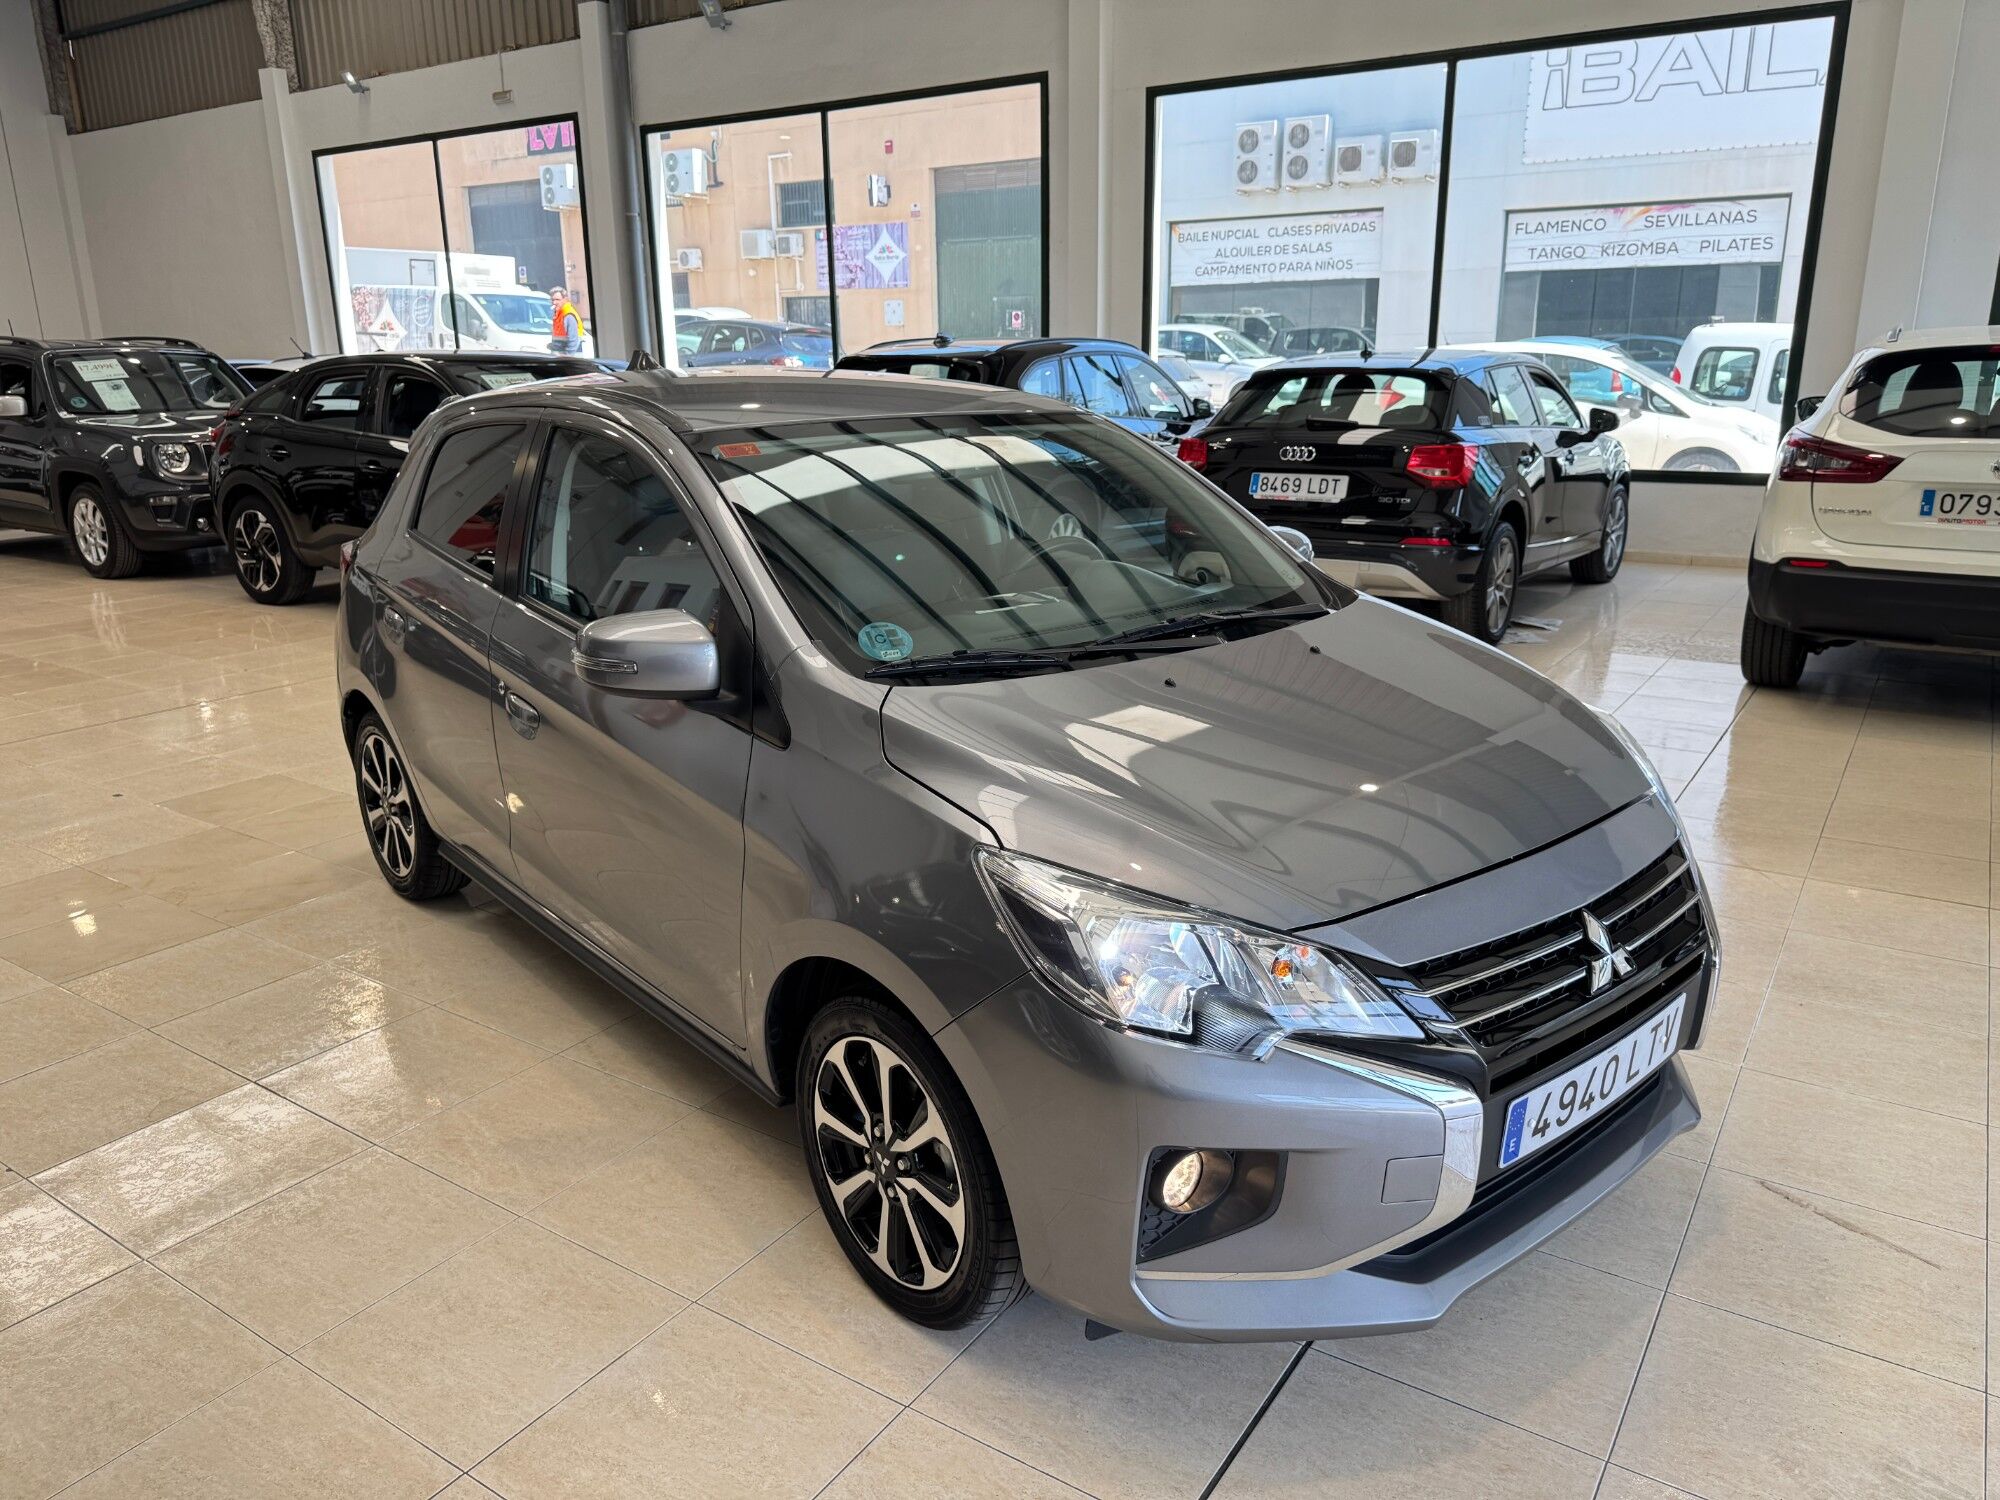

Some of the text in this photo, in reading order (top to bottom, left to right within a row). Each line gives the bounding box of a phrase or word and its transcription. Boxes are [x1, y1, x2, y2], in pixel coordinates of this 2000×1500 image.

[1178, 221, 1376, 243] BAILE NUPCIAL CLASES PRIVADAS
[1515, 209, 1758, 235] FLAMENCO SEVILLANAS
[1214, 241, 1333, 259] ALQUILER DE SALAS
[1528, 236, 1774, 260] TANGO KIZOMBA PILATES
[1195, 257, 1354, 277] CAMPAMENTO PARA NIÑOS
[1259, 476, 1341, 495] 8469 LDT
[1508, 1006, 1680, 1153] E 4940 LTV
